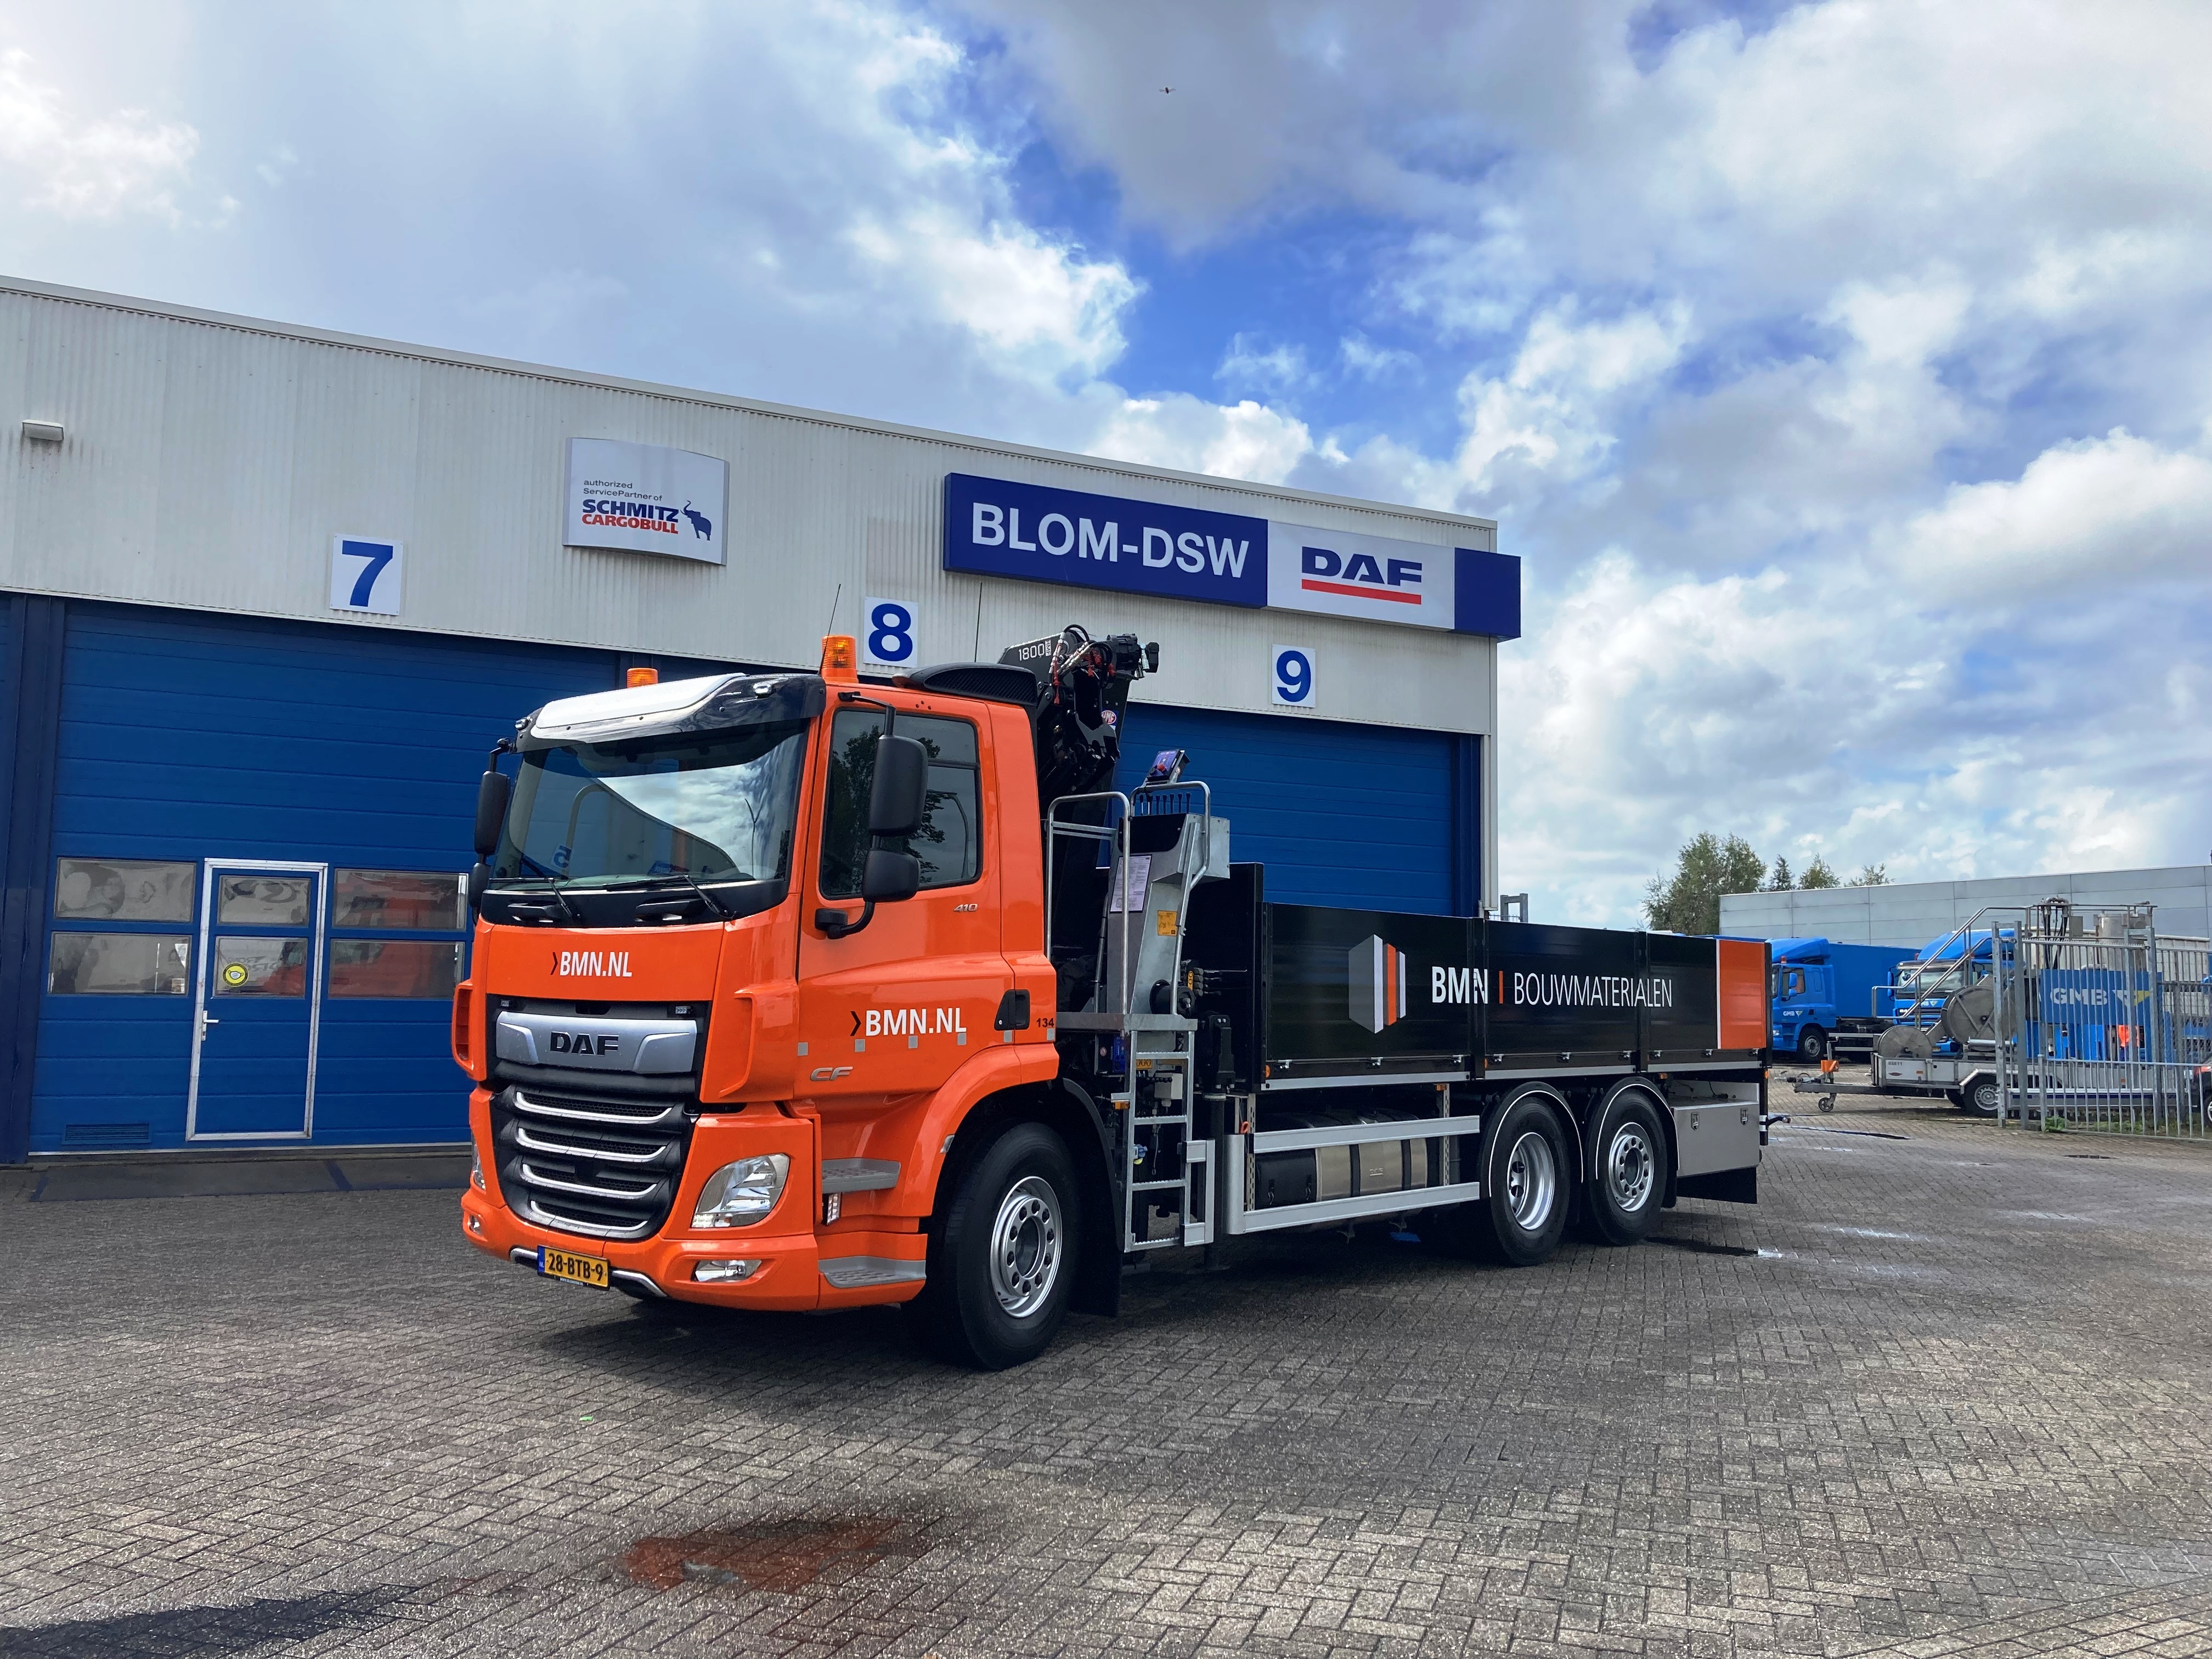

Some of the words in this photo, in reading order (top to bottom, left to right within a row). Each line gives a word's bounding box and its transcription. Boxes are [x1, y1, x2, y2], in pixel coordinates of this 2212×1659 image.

[583, 479, 633, 489] authorized
[583, 488, 652, 500] ServicePartner
[583, 499, 679, 523] SCHMITZ
[582, 514, 679, 534] CARGOBULL
[972, 502, 1250, 579] BLOM-DSW
[342, 540, 394, 607] 7
[1301, 546, 1423, 586] DAF
[868, 603, 913, 662] 8
[1018, 643, 1045, 661] 1800
[1276, 650, 1311, 703] 9
[953, 903, 978, 912] 410
[559, 951, 633, 977] BMN.NL
[1432, 966, 1488, 1004] BMN
[1514, 972, 1672, 1007] BOUWMATERIALEN
[2050, 988, 2108, 1006] GMB
[865, 1007, 967, 1036] BMN.NL
[1036, 1018, 1055, 1028] 134
[549, 1031, 619, 1056] DAF
[810, 1066, 854, 1081] CF
[548, 1252, 603, 1282] 28-BTB-9
